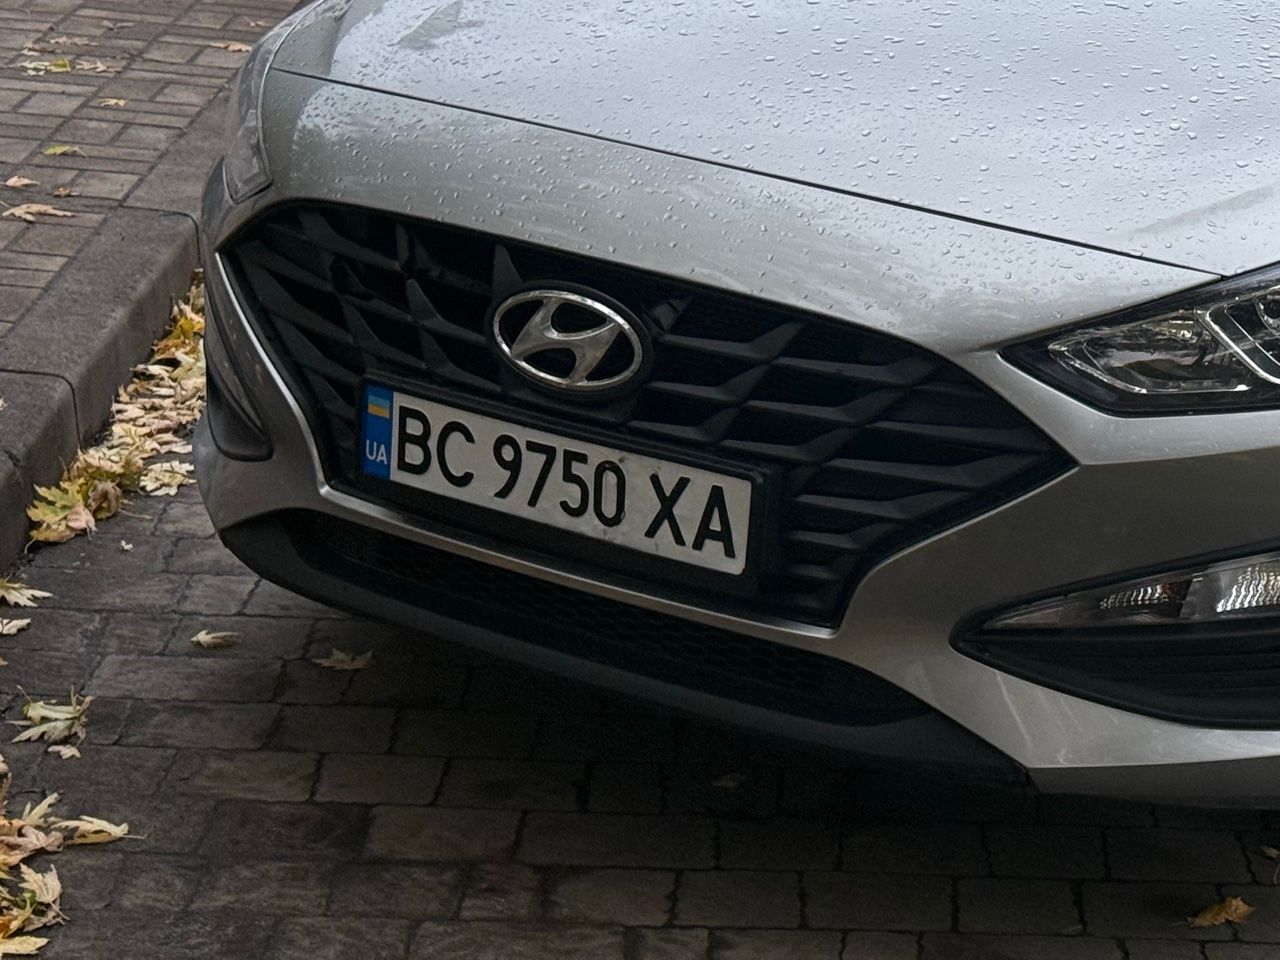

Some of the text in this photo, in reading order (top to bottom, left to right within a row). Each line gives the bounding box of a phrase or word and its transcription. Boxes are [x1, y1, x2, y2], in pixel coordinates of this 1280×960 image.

[365, 439, 389, 465] UA
[396, 405, 736, 559] BC 9750 XA
